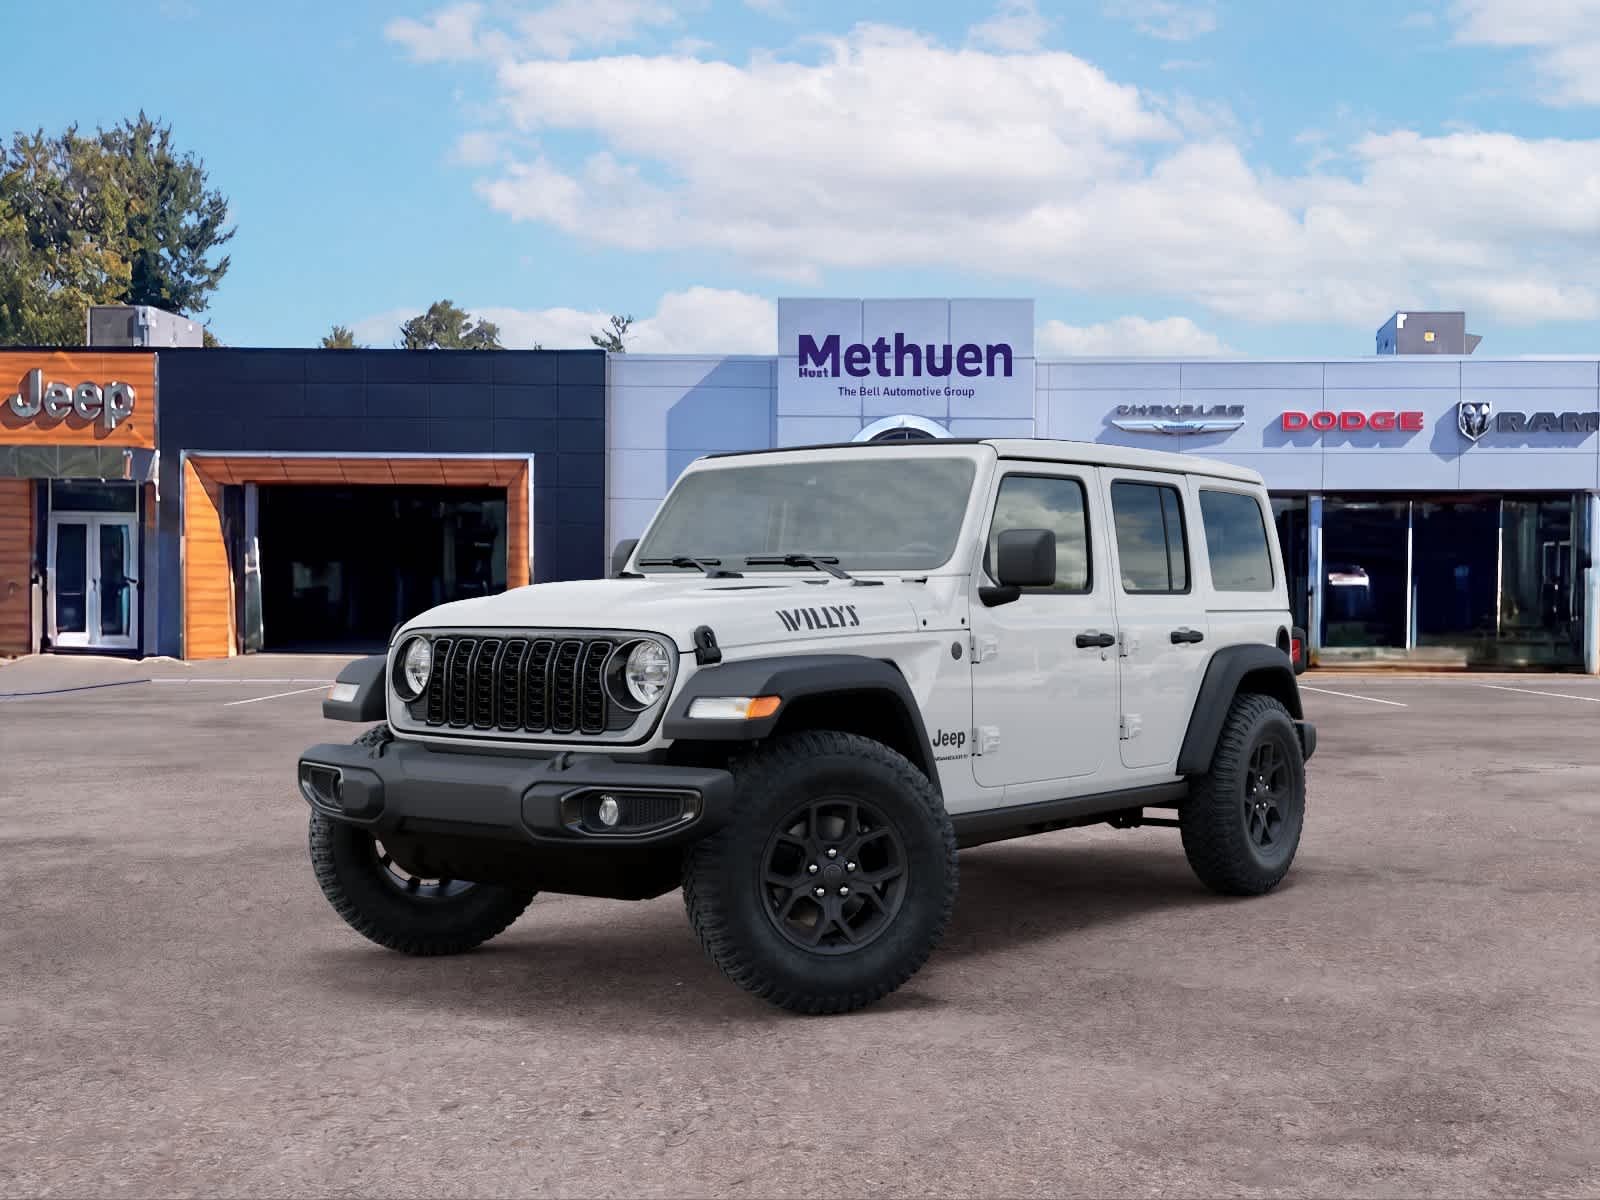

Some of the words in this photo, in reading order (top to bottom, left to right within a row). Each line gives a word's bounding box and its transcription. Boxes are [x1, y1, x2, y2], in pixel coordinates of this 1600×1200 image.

[798, 333, 1013, 377] Methuen
[9, 368, 136, 430] Jeep
[838, 387, 857, 396] The
[860, 387, 880, 396] Bell
[883, 387, 941, 396] Automotive
[944, 387, 975, 398] Group
[1282, 411, 1424, 432] DODGE
[1497, 412, 1600, 432] RAM
[776, 605, 860, 632] WILLYS
[933, 729, 965, 748] Jeep
